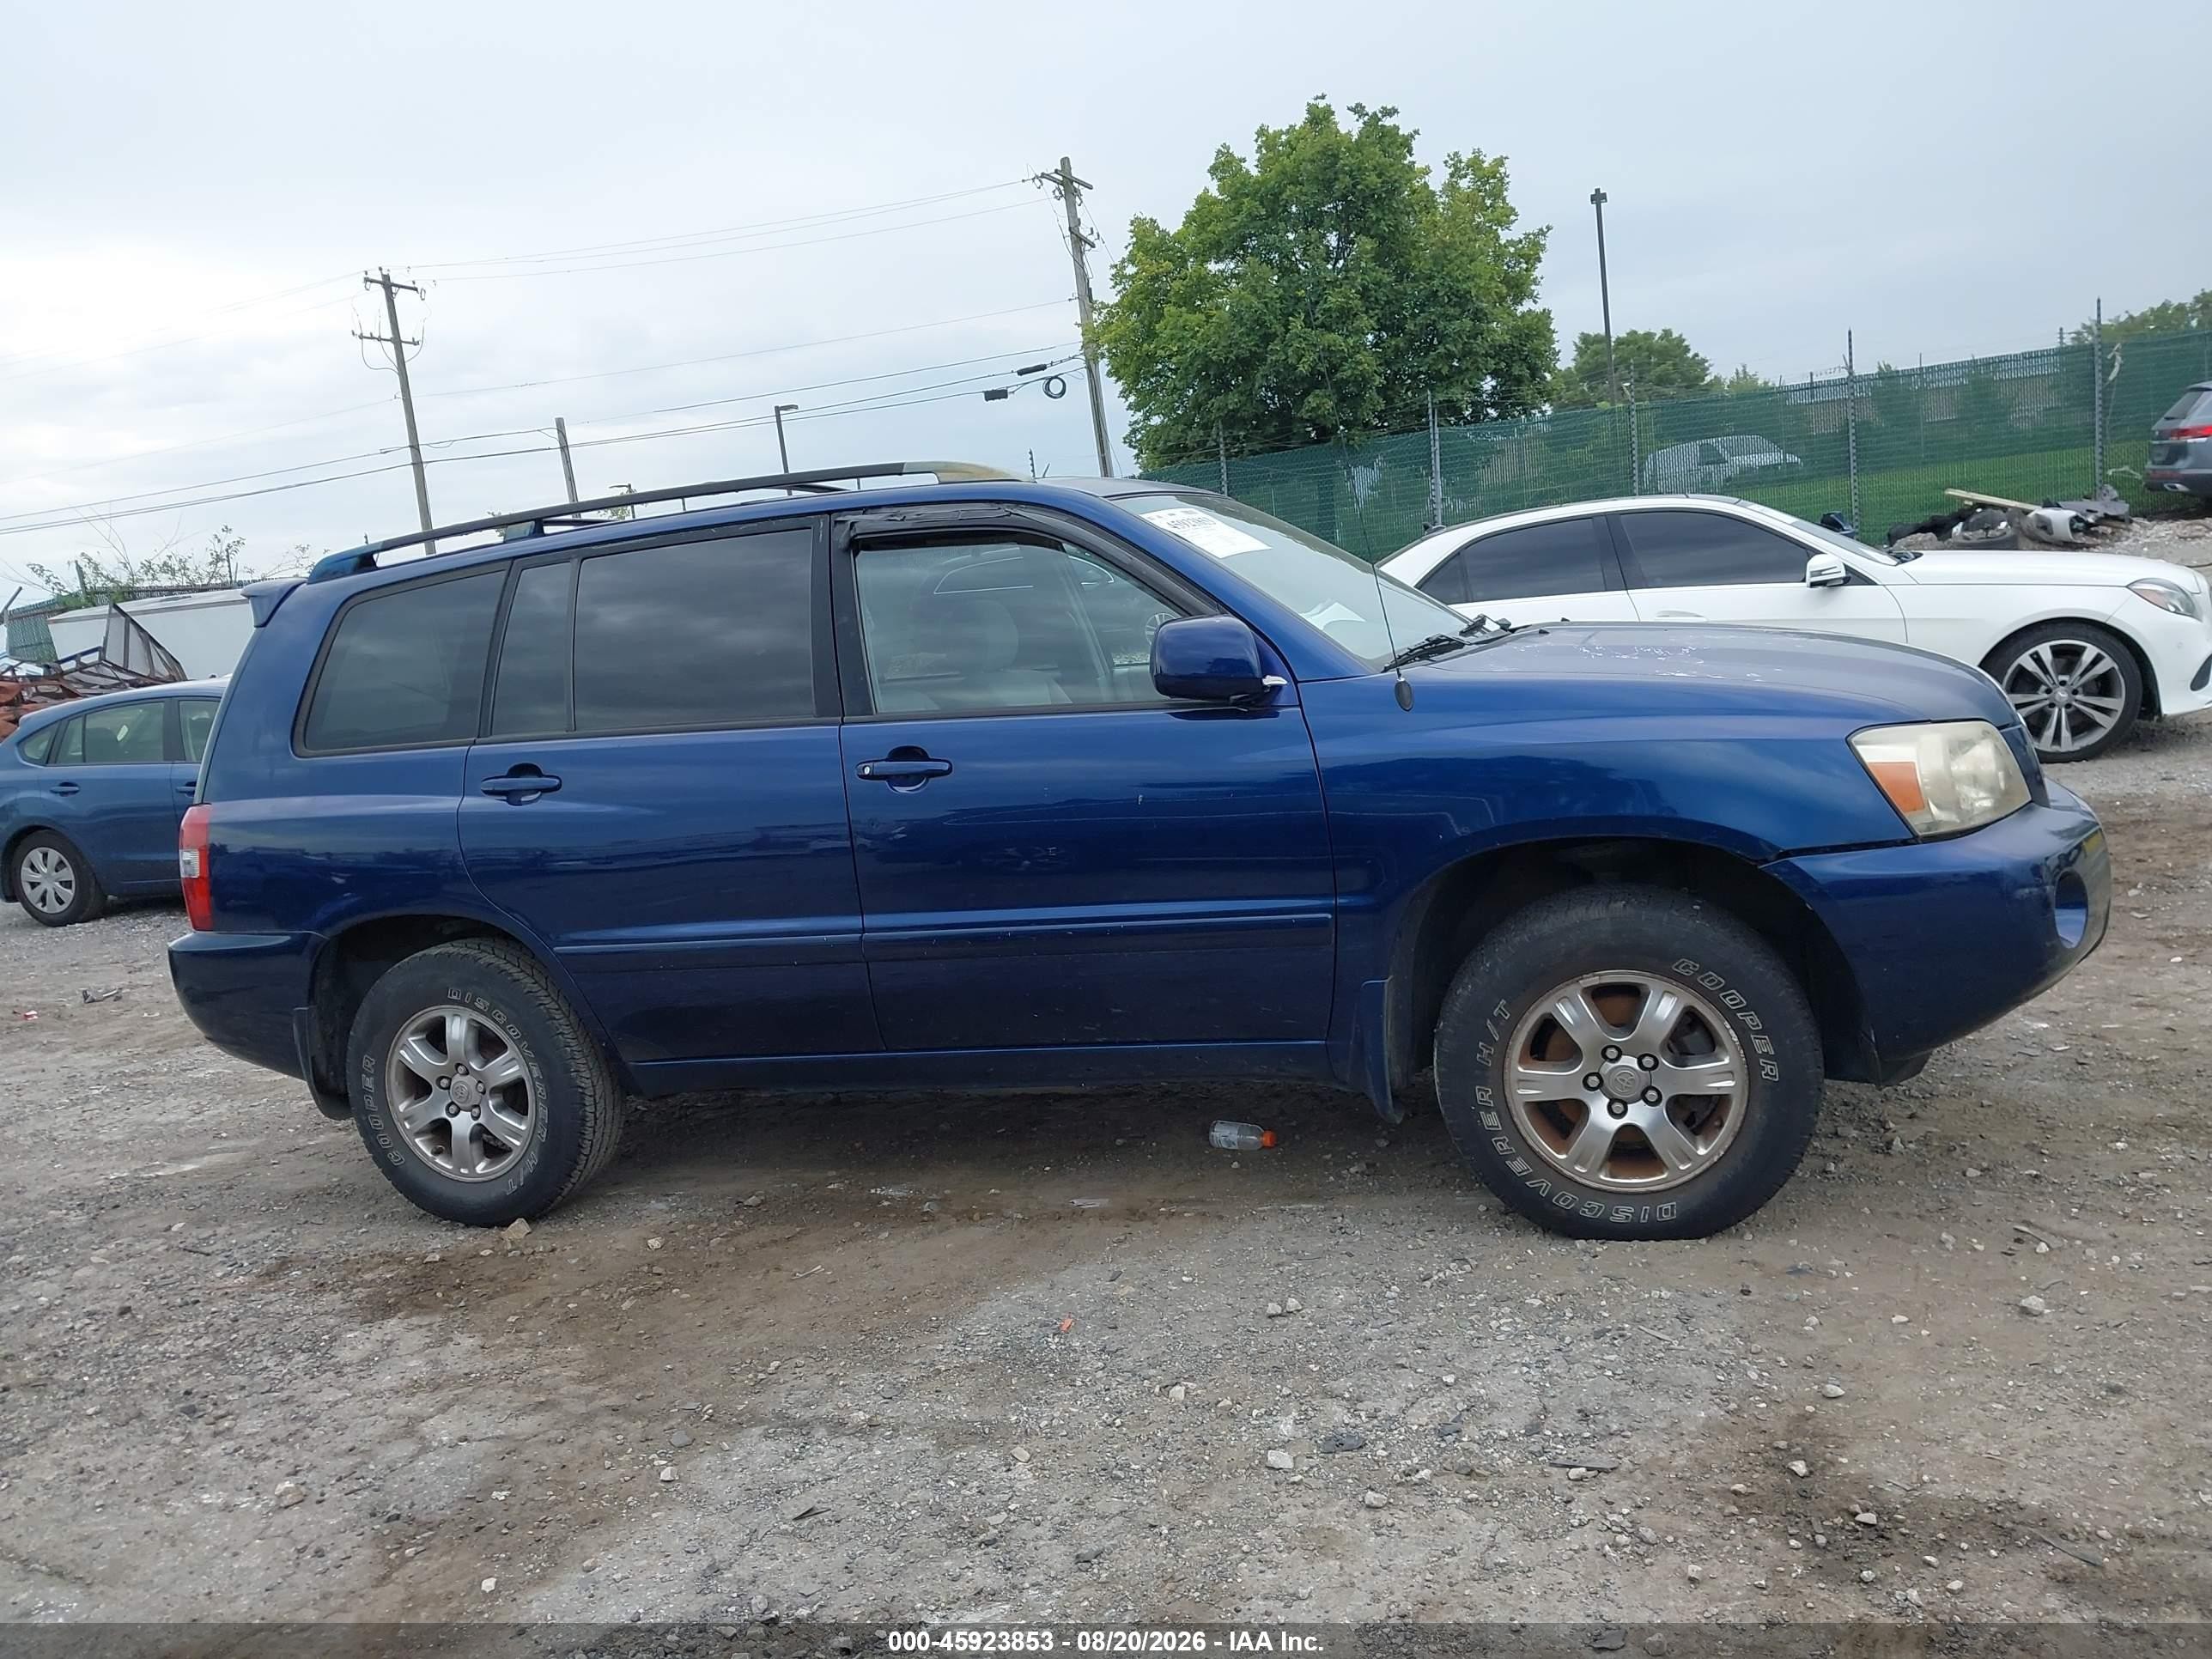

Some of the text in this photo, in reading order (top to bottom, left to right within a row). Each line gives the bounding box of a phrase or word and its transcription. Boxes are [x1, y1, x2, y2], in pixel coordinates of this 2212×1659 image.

[447, 988, 550, 1196] DISCOVERER H/T
[1672, 958, 1779, 1082] COOPER
[362, 1054, 405, 1167] COOPER
[1475, 999, 1677, 1224] DISCOVERER H/T
